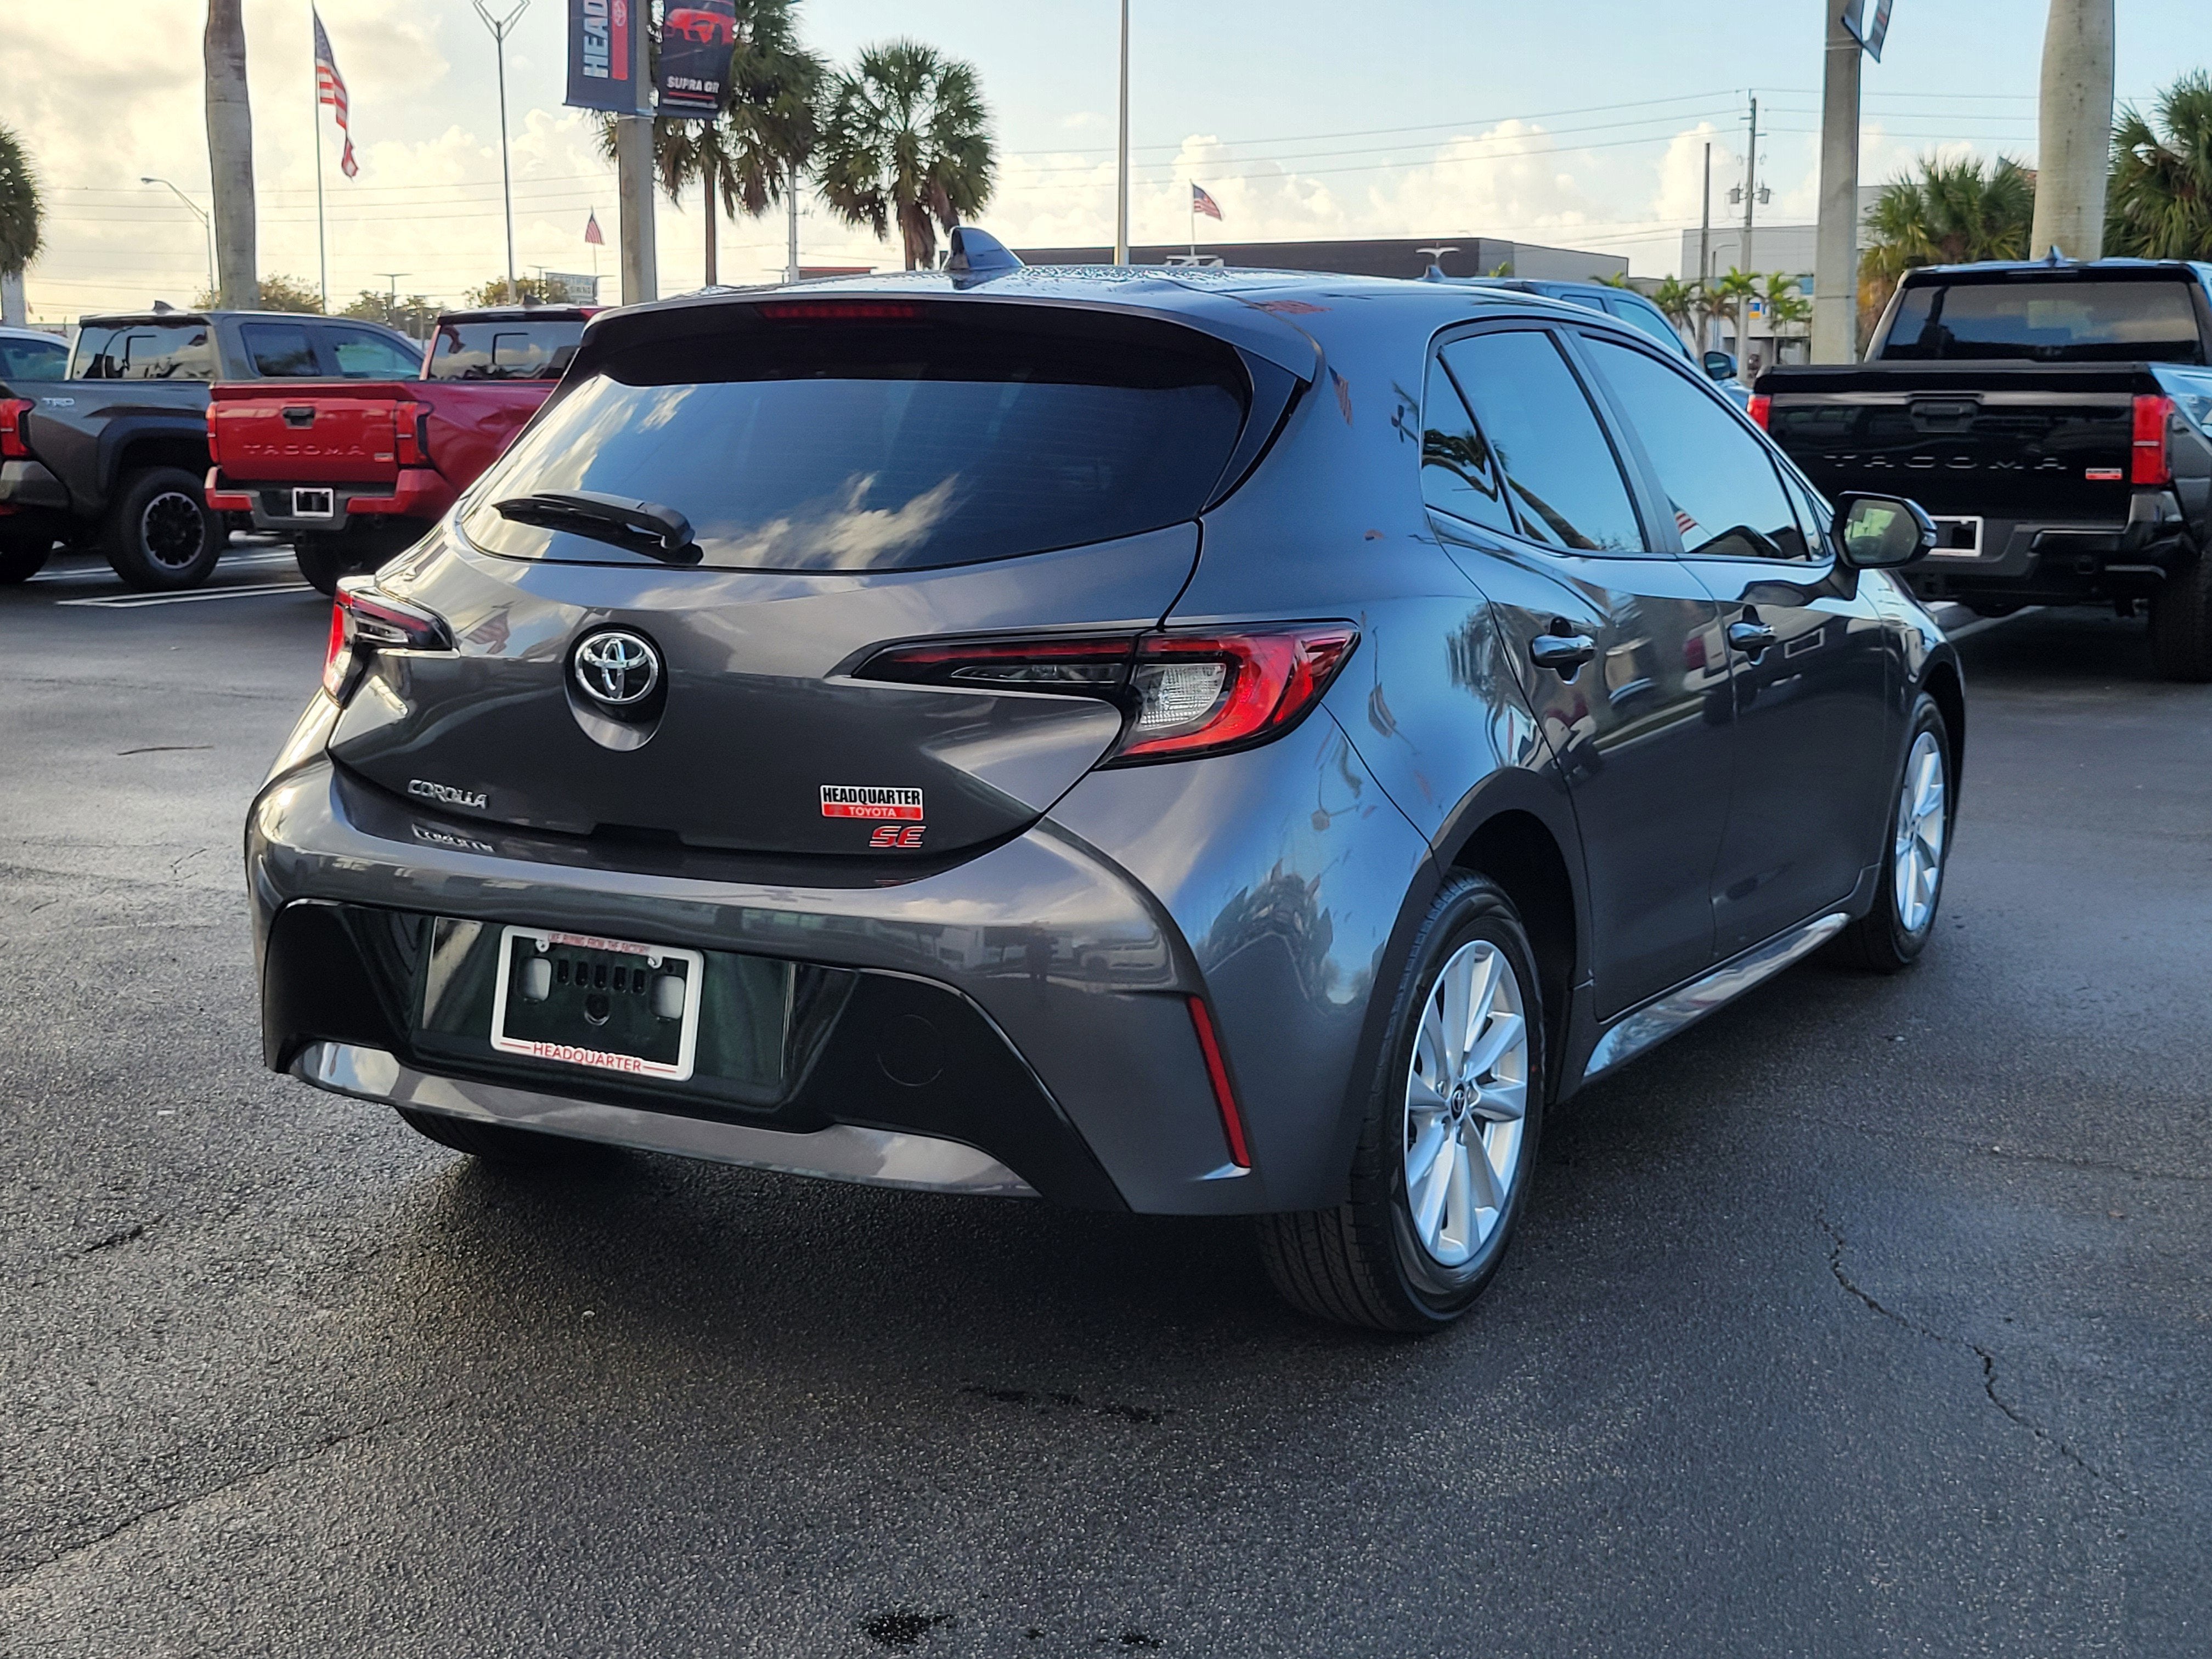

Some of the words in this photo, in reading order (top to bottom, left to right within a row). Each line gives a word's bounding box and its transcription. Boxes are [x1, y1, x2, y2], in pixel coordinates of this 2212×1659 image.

[583, 0, 608, 78] HEAD
[667, 76, 702, 91] SUPRA
[704, 81, 720, 94] GR
[42, 397, 75, 407] TRD
[243, 444, 365, 455] TACOMA
[1823, 455, 2067, 470] TACOMA
[408, 780, 487, 809] COROLLA
[823, 787, 920, 805] HEADQUARTER
[849, 806, 896, 817] TOYOTA
[868, 826, 927, 848] SE
[533, 1043, 641, 1071] HEADQUARTER
